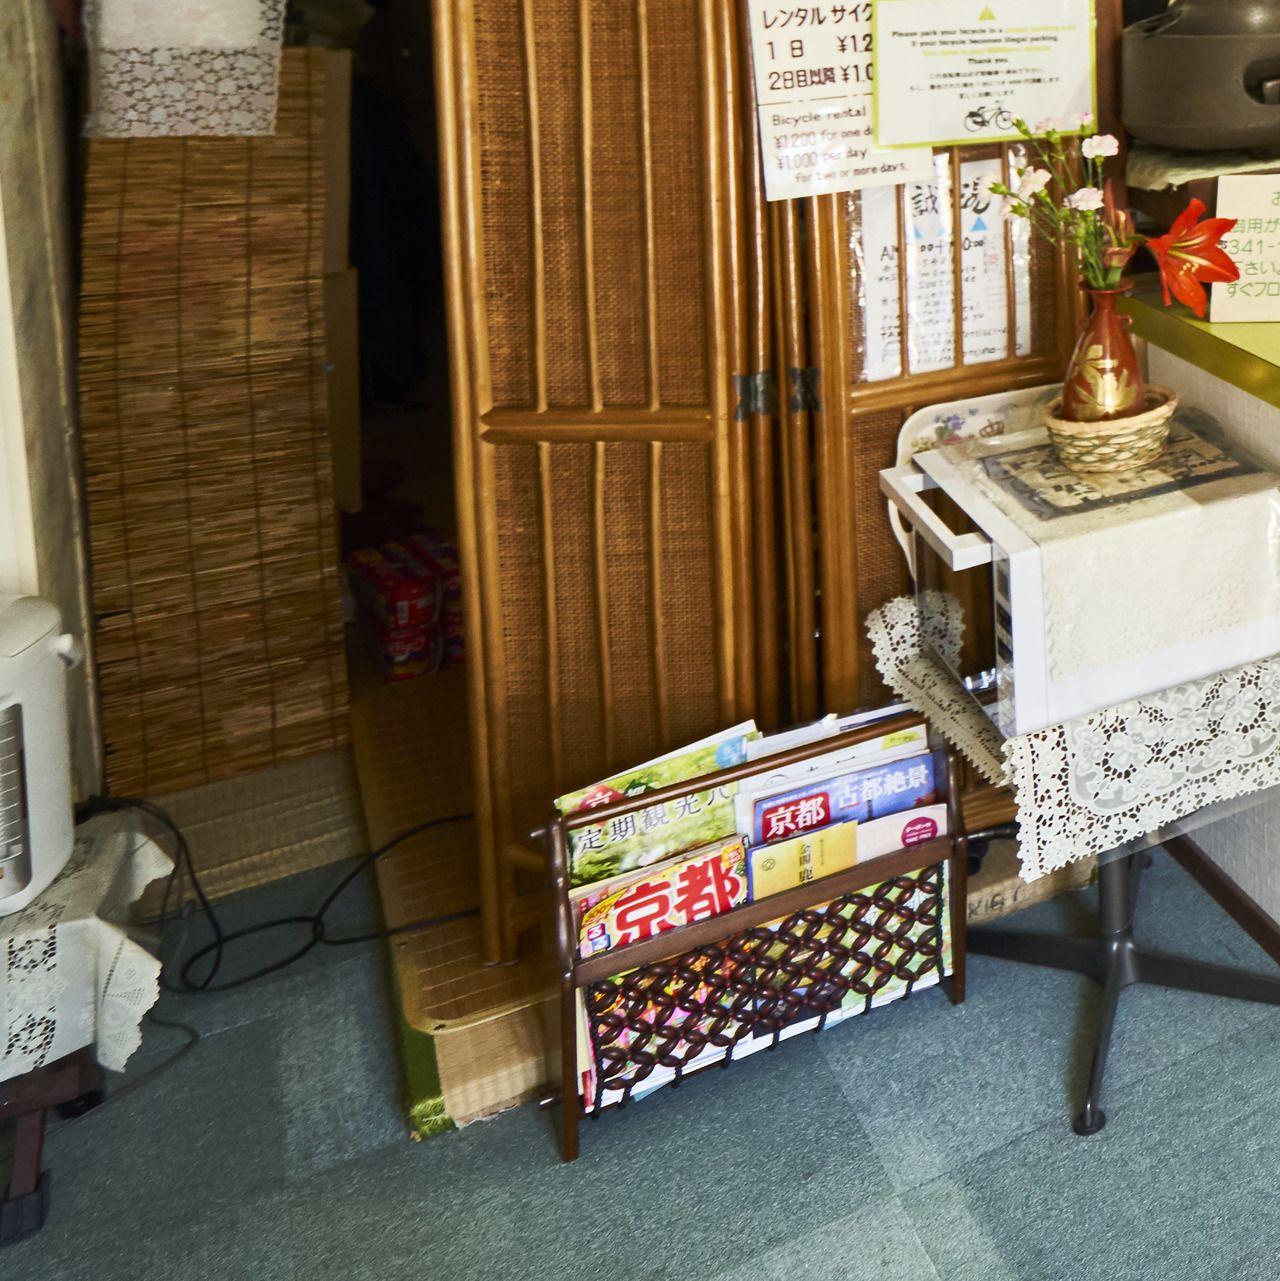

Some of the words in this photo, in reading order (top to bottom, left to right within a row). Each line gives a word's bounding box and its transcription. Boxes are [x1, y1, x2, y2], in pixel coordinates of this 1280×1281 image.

[772, 111, 821, 127] Bicycle
[826, 105, 866, 120] rental
[820, 129, 838, 141] for
[846, 147, 867, 160] day
[795, 172, 812, 183] for
[854, 166, 878, 176] more
[839, 764, 929, 808] 古都絶景
[766, 796, 826, 837] 京都
[613, 854, 741, 948] 京都
